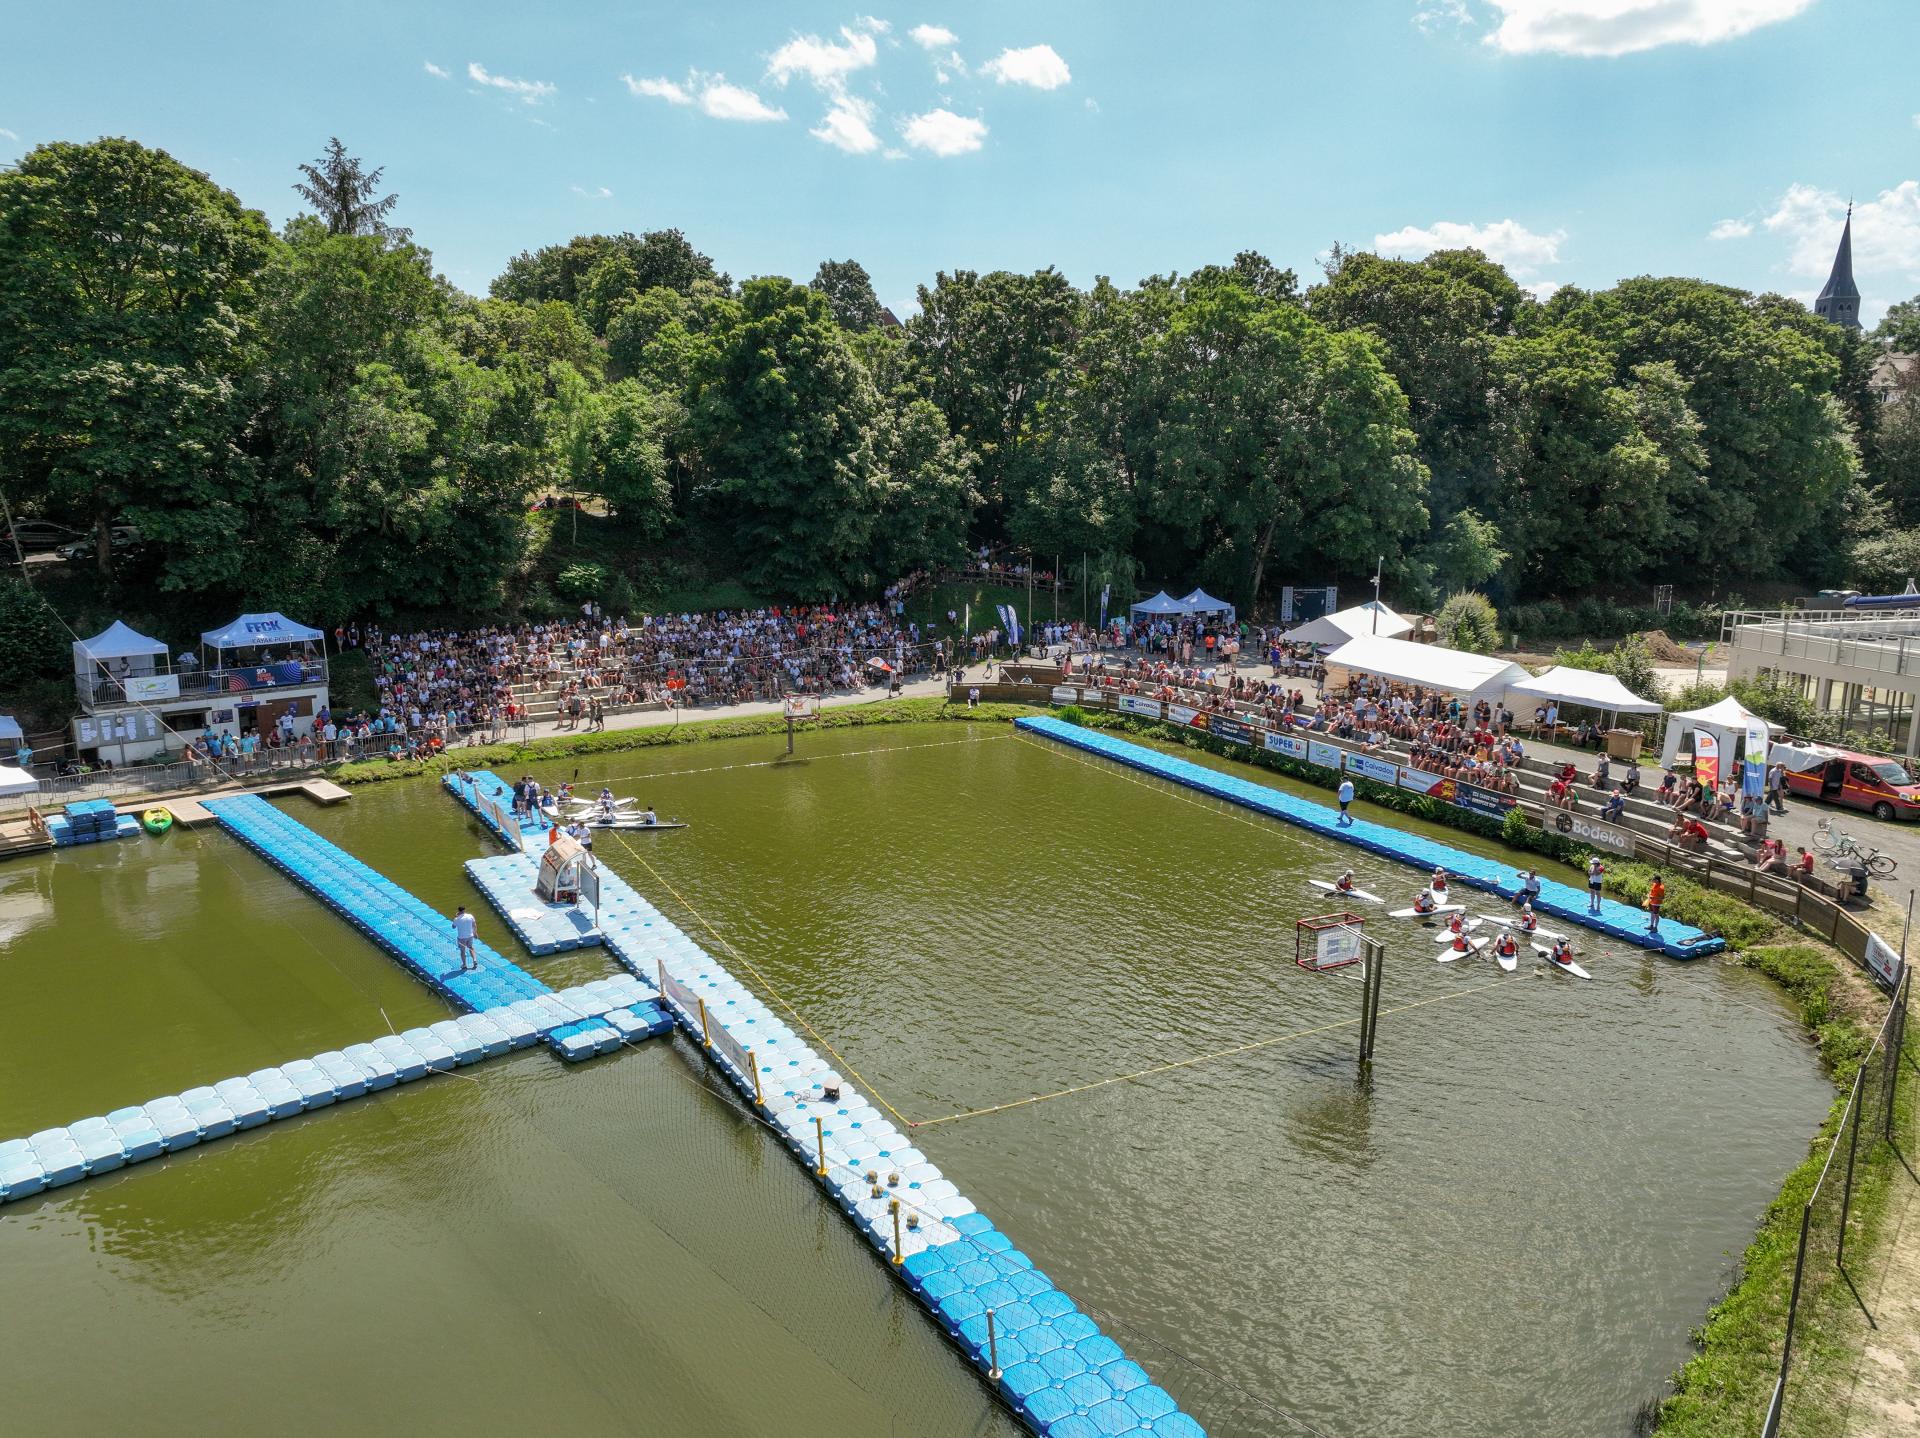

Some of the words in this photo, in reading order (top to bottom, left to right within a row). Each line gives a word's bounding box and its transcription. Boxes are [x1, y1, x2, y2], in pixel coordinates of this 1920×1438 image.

[245, 620, 282, 633] FFCK
[1269, 735, 1293, 750] SUPER
[1295, 743, 1301, 751] U
[1364, 761, 1394, 776] Calvados
[1572, 819, 1625, 848] Bodeko
